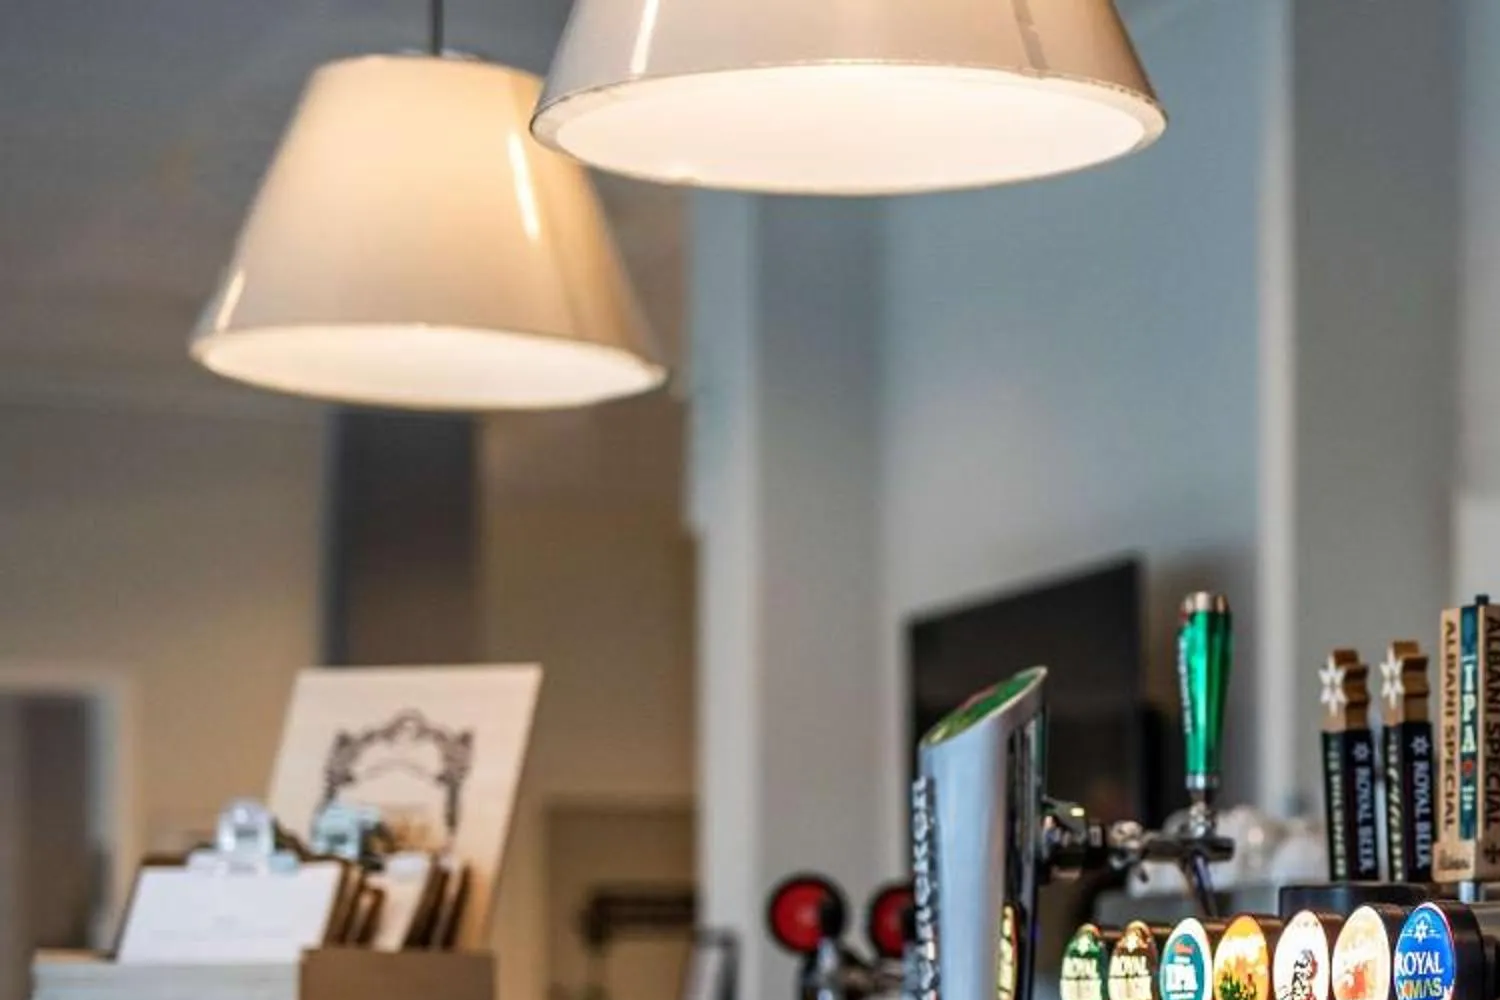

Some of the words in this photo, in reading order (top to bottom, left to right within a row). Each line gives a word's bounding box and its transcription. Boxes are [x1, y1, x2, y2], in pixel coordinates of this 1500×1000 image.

[1444, 620, 1457, 717] ALBANI
[1461, 662, 1477, 754] IPA
[1355, 767, 1373, 824] ROYAL
[1411, 761, 1430, 819] ROYAL
[1443, 723, 1457, 831] SPECIAL
[1357, 826, 1374, 873] BEER
[1415, 821, 1432, 868] BEER
[1396, 952, 1444, 976] ROYAL
[1399, 978, 1443, 1000] XMAS
